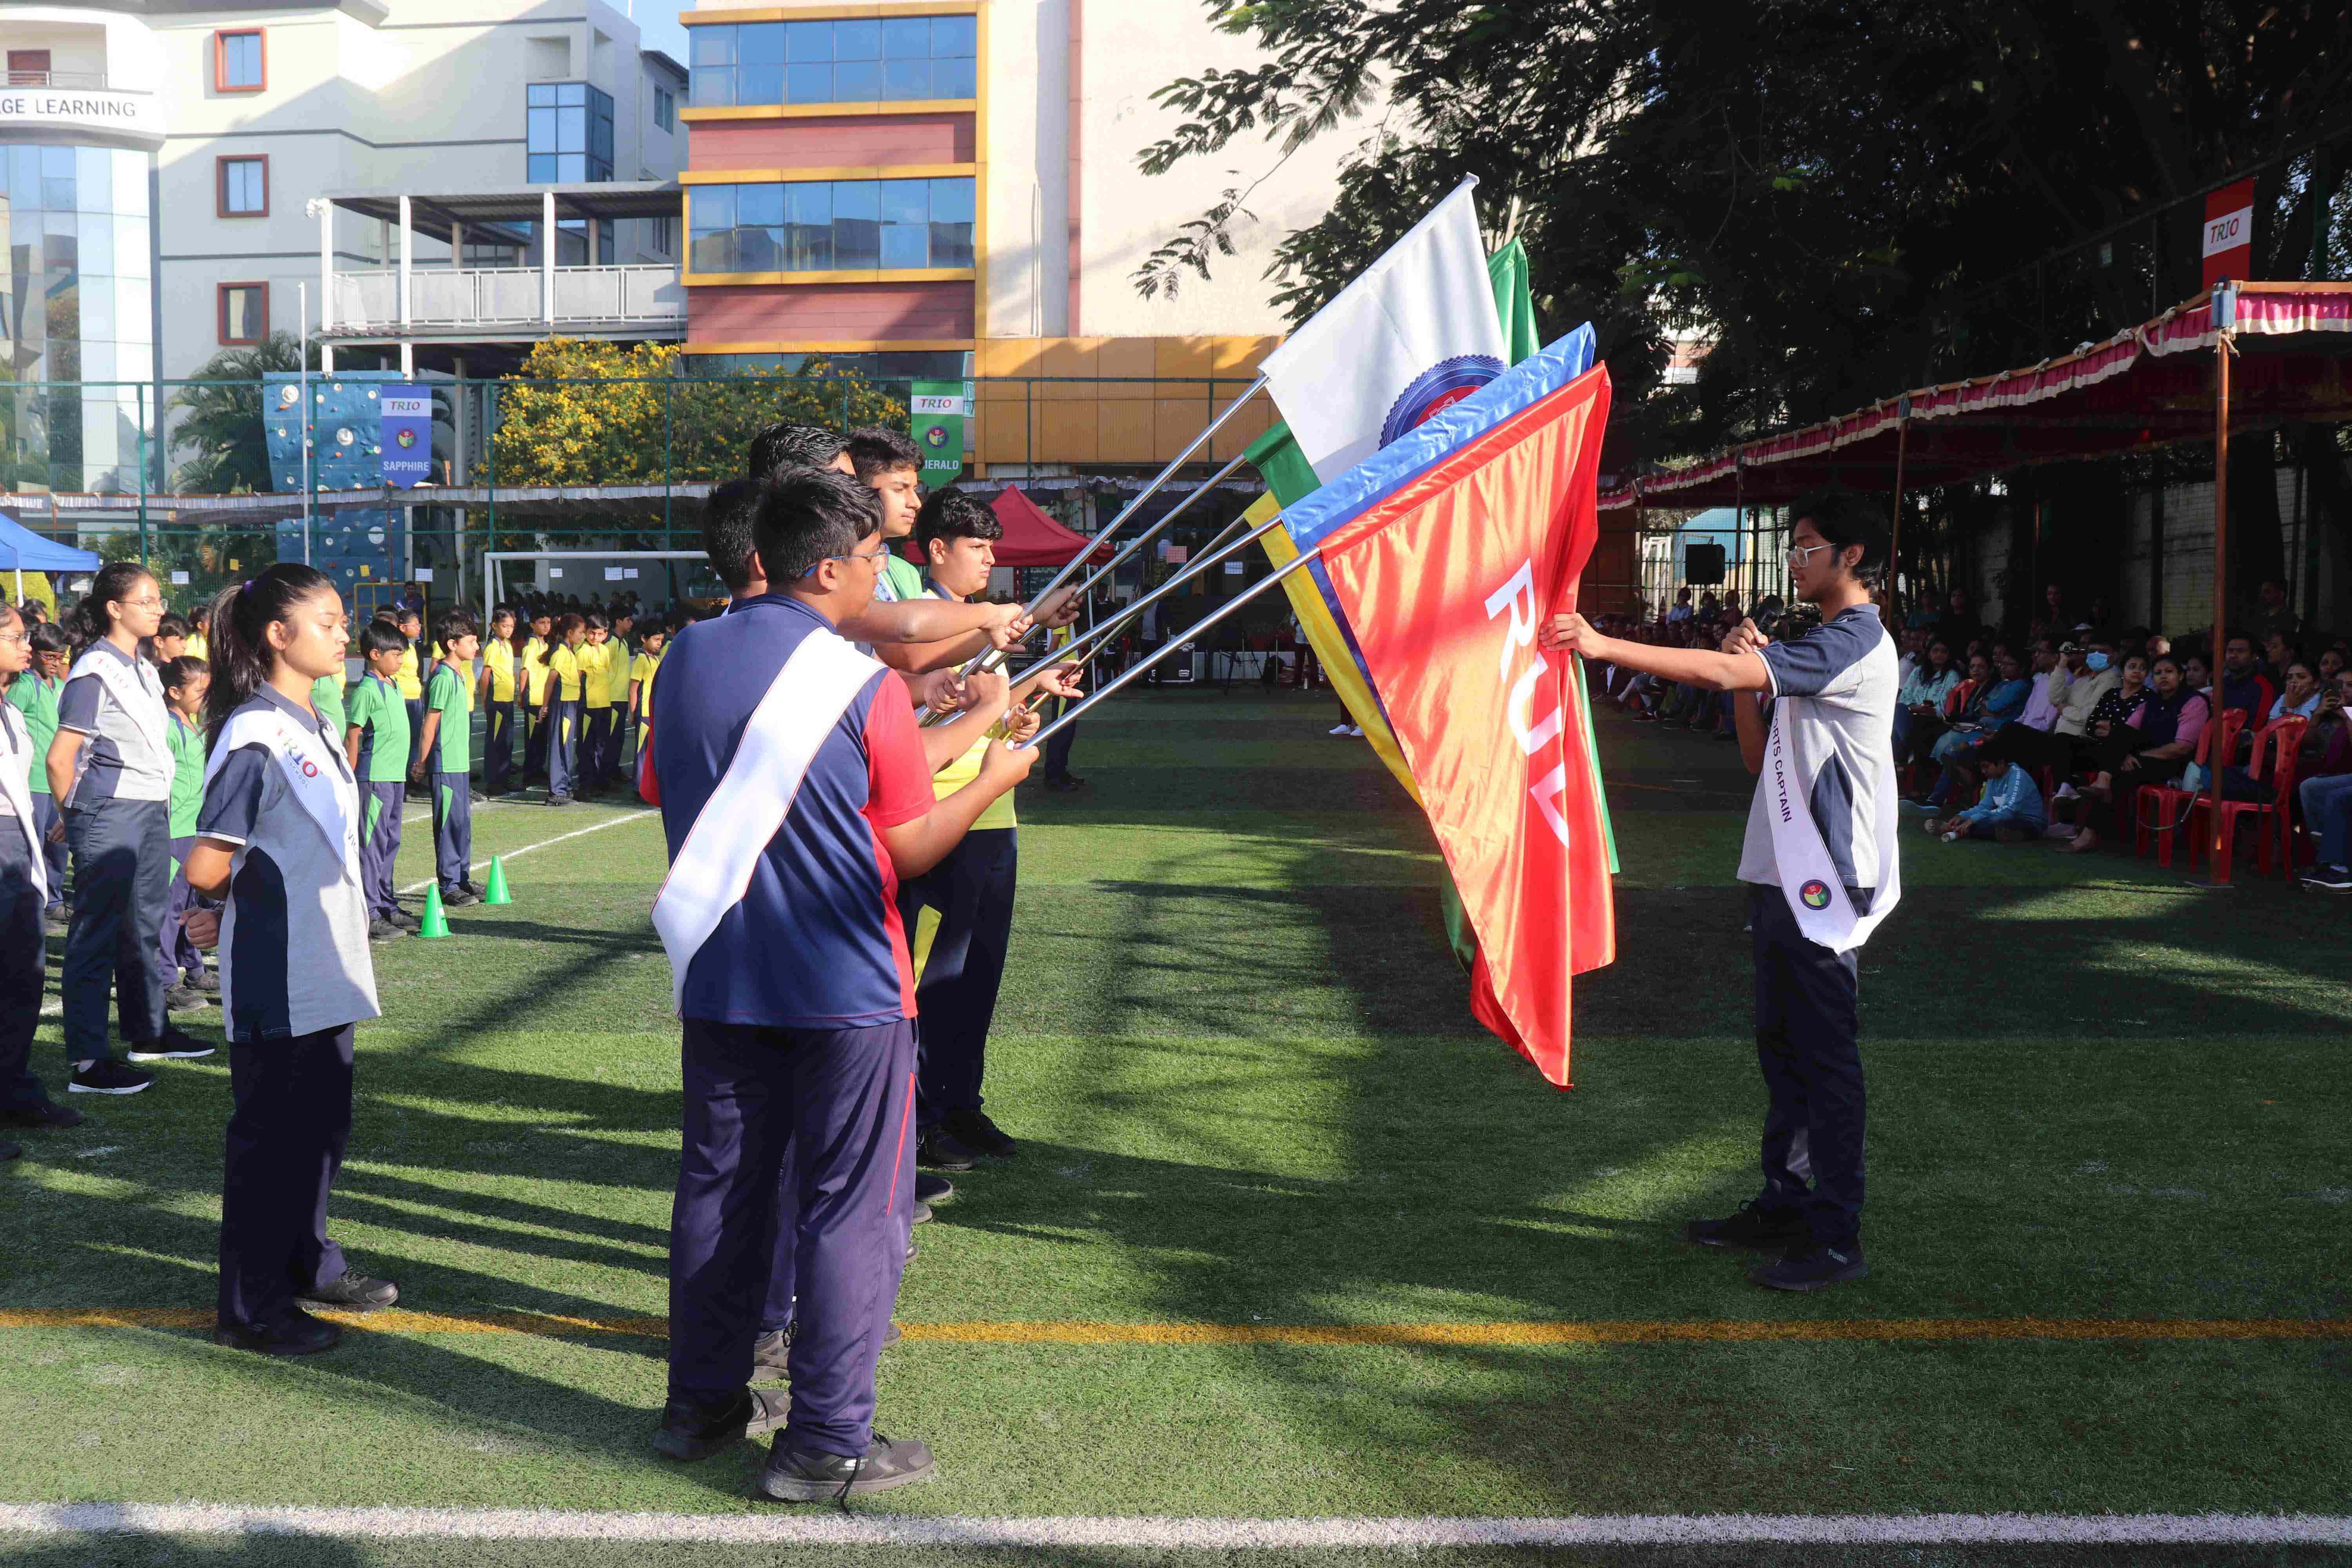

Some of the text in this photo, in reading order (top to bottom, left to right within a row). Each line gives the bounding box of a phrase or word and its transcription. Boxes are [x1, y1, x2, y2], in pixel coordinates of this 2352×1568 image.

[0, 98, 135, 116] GE LEARNING
[2211, 218, 2239, 243] TRIO
[390, 401, 421, 410] TRIO
[920, 399, 952, 408] TRIO
[383, 461, 429, 471] SAPPHIRE
[1775, 759, 1792, 822] CAPTAIN
